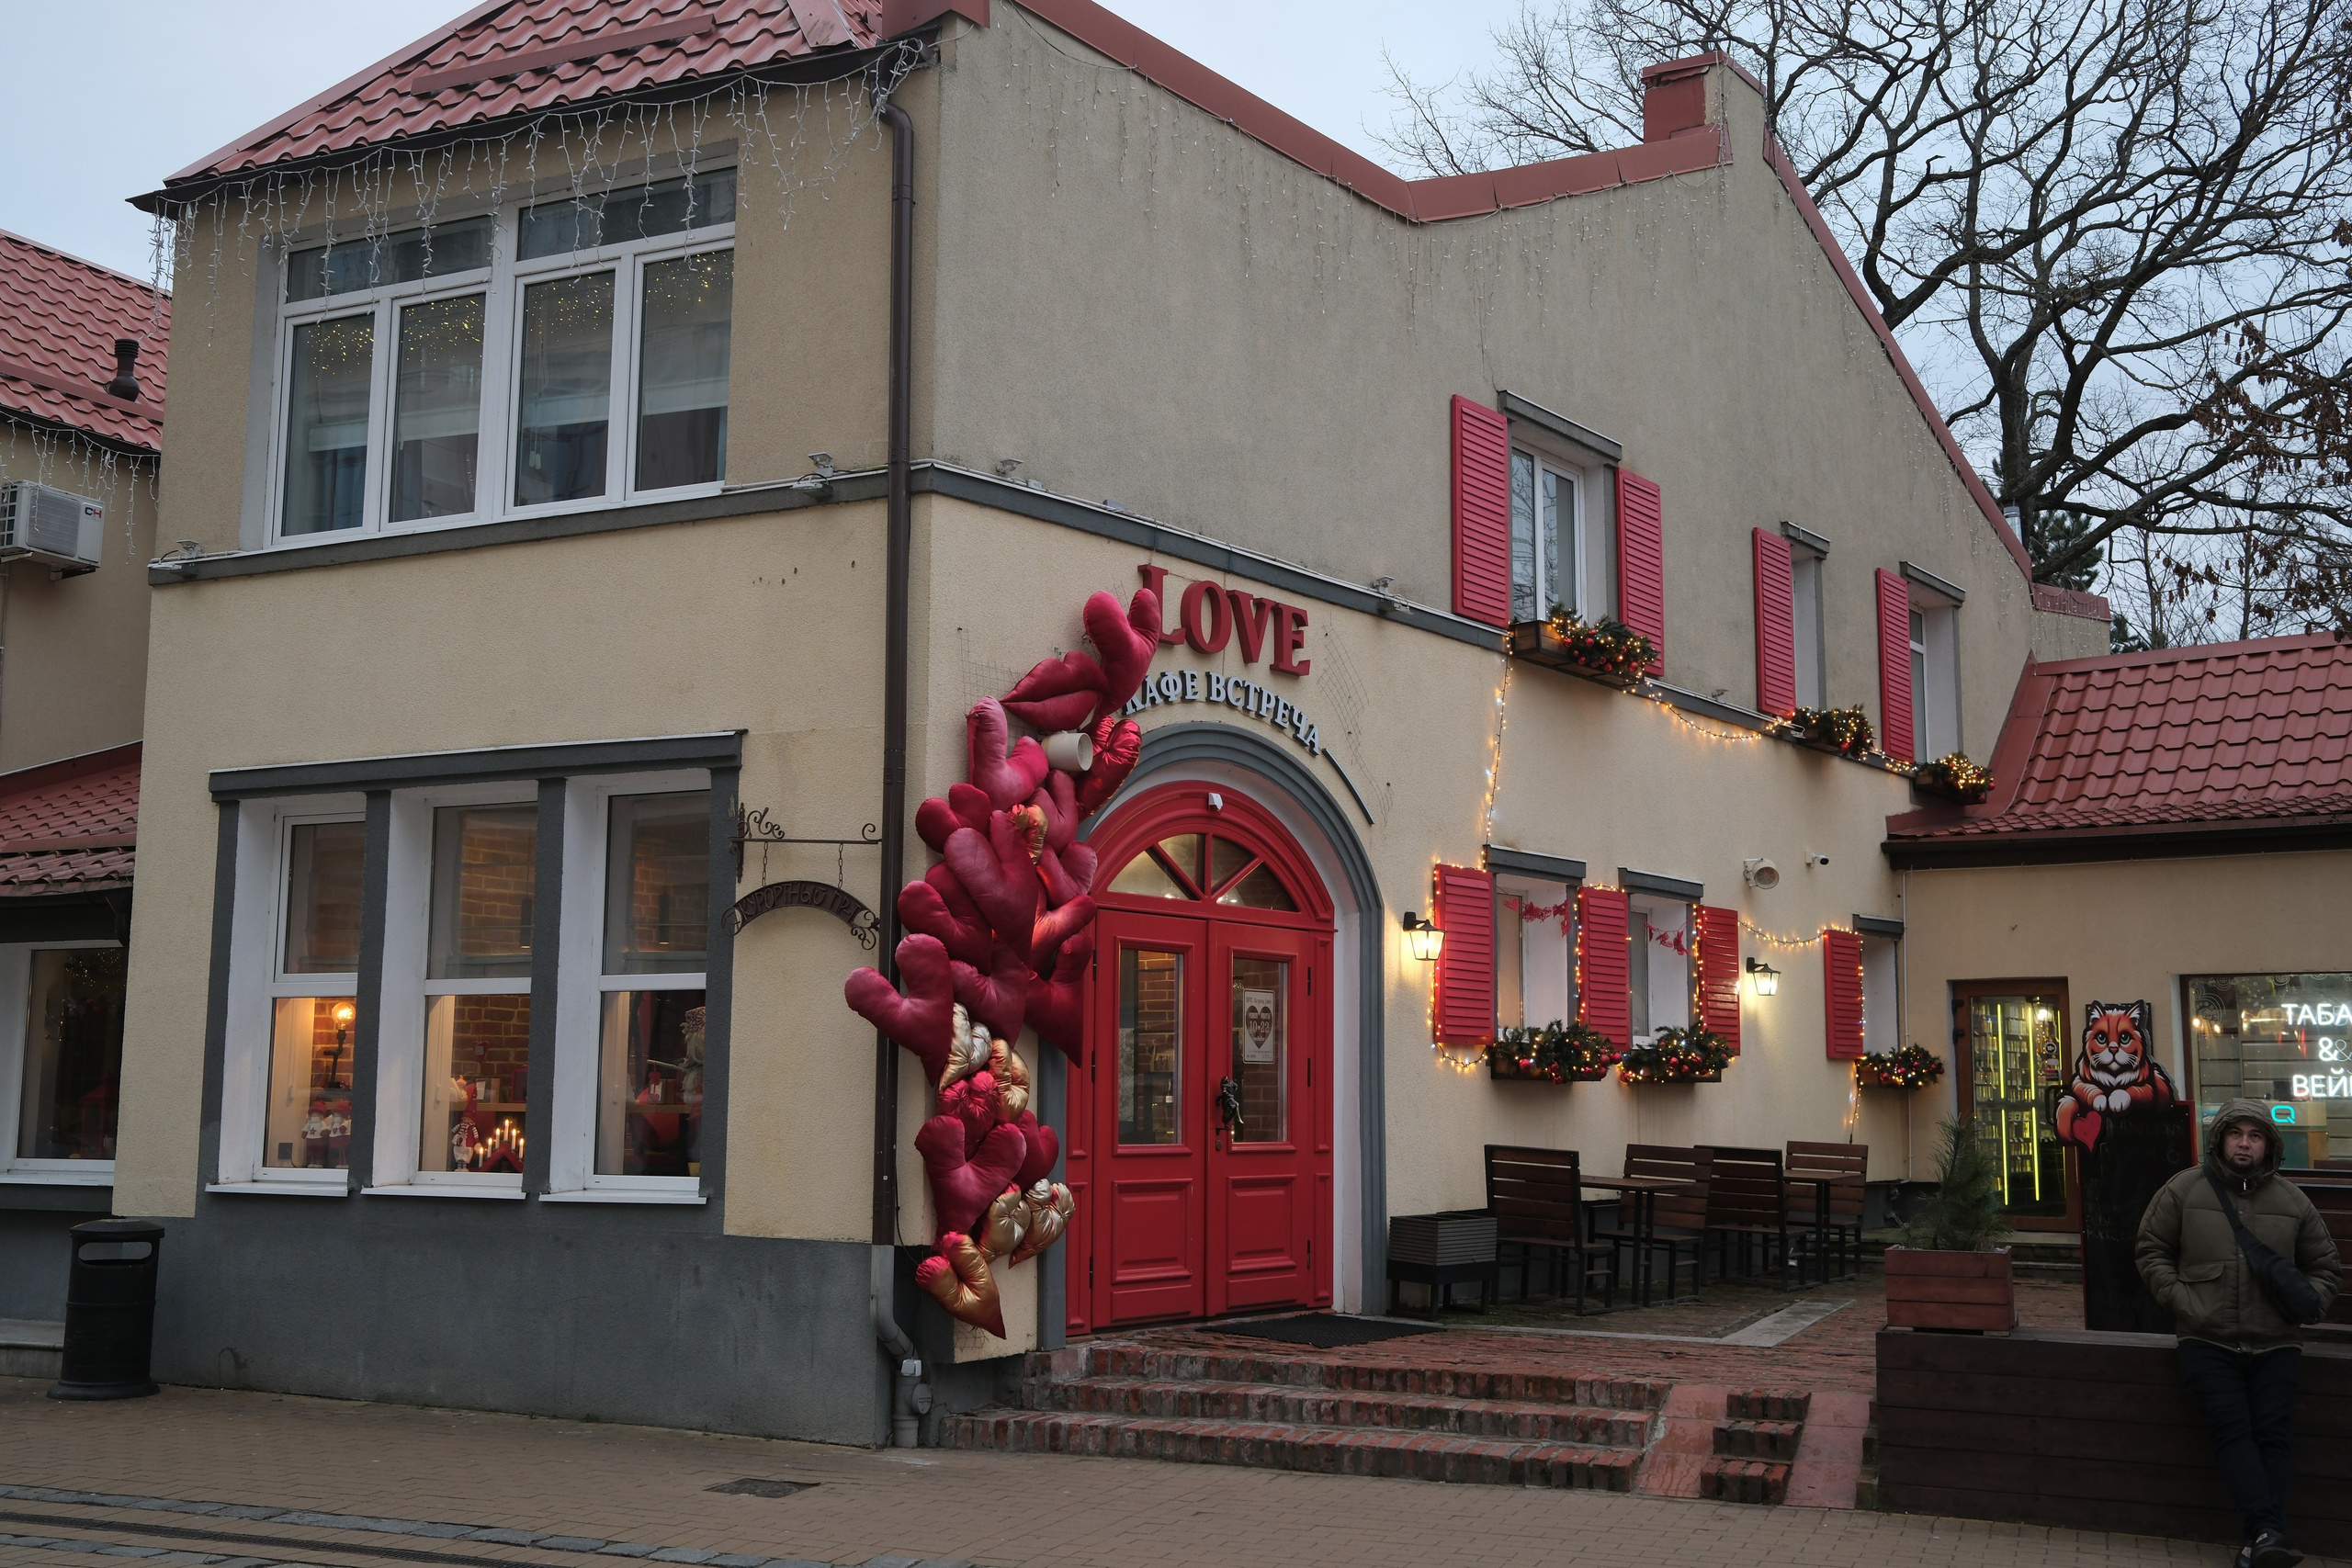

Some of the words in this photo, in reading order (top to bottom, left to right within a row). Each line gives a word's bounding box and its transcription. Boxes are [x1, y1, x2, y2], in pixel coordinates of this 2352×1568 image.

[1137, 564, 1311, 676] LOVE
[1205, 671, 1320, 756] ВСТРЕЧА
[738, 883, 827, 921] КУРОРТНЫЙ
[1250, 1021, 1258, 1032] 10
[1260, 1021, 1270, 1033] 22
[2280, 1003, 2352, 1026] ТАБА
[2319, 1037, 2339, 1062] &
[2292, 1067, 2352, 1097] ВЕЙ
